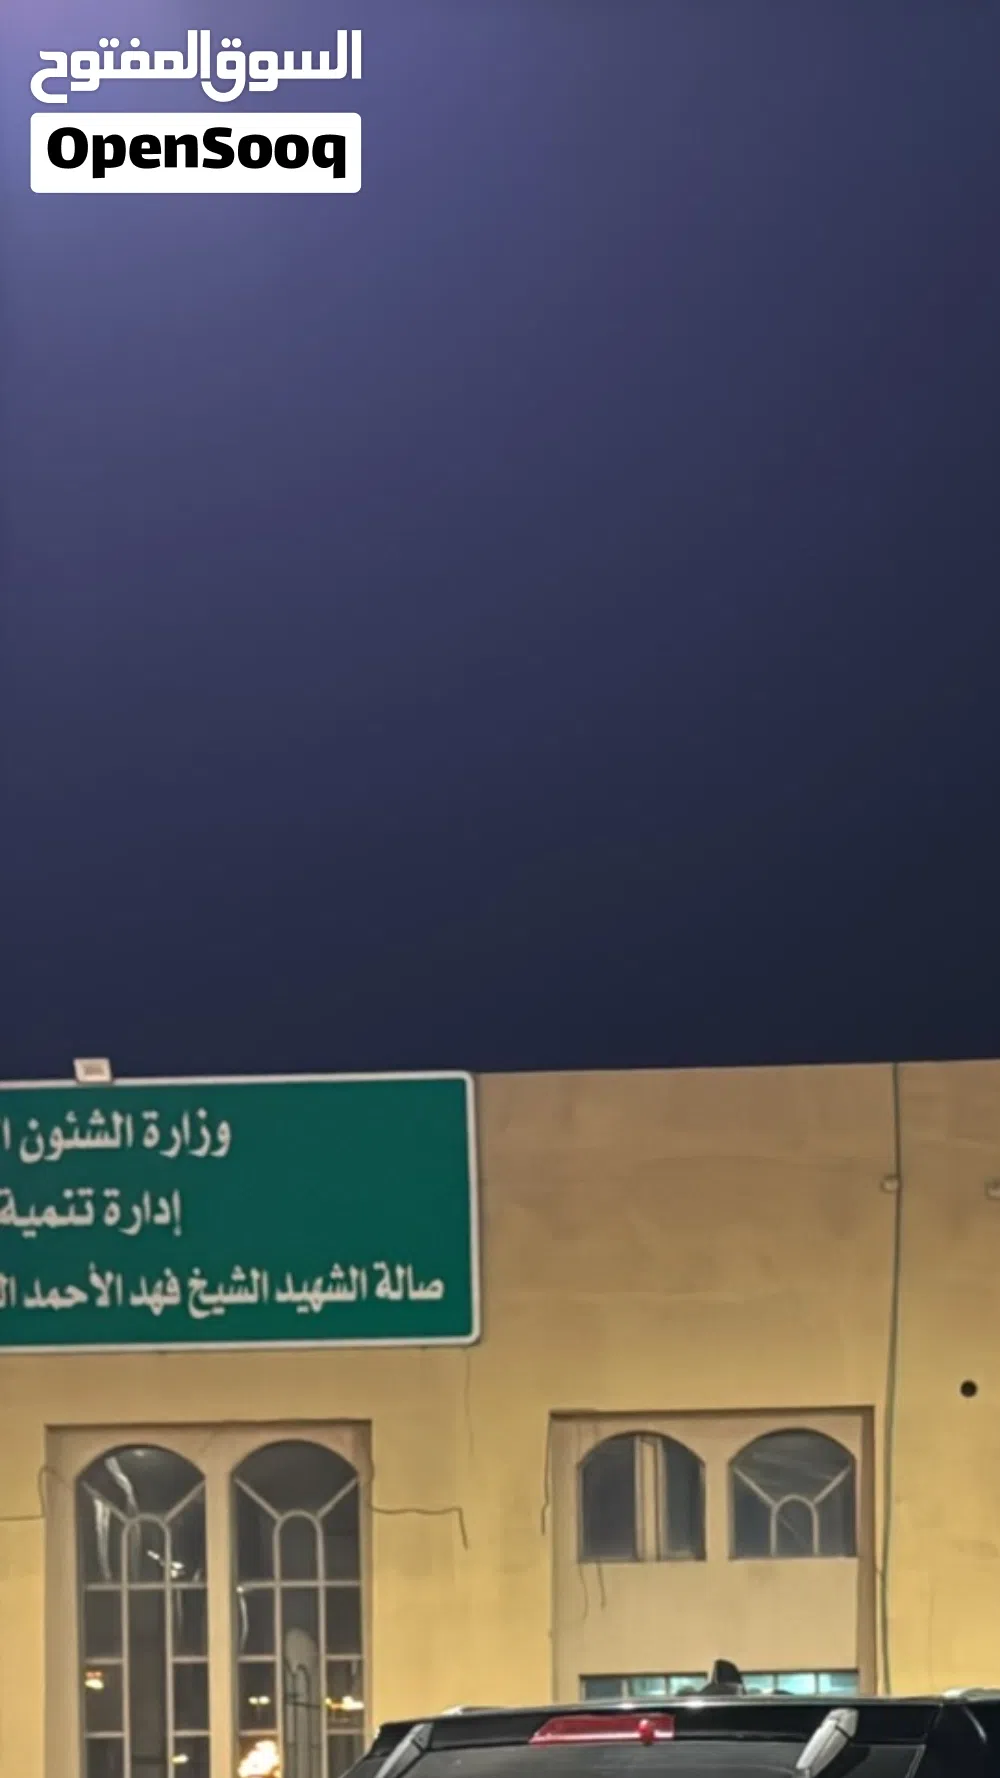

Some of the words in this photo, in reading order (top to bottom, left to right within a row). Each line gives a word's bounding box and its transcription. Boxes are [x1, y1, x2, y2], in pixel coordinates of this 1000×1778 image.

[19, 1108, 134, 1164] الشئون
[141, 1107, 232, 1158] وزارة
[0, 1186, 95, 1239] تنمية
[103, 1188, 182, 1237] إدارة
[23, 1260, 124, 1310] الأحمد
[129, 1266, 182, 1316] فهد
[187, 1264, 269, 1319] الشيخ
[274, 1262, 368, 1314] الشهيد
[374, 1260, 444, 1300] صالة
